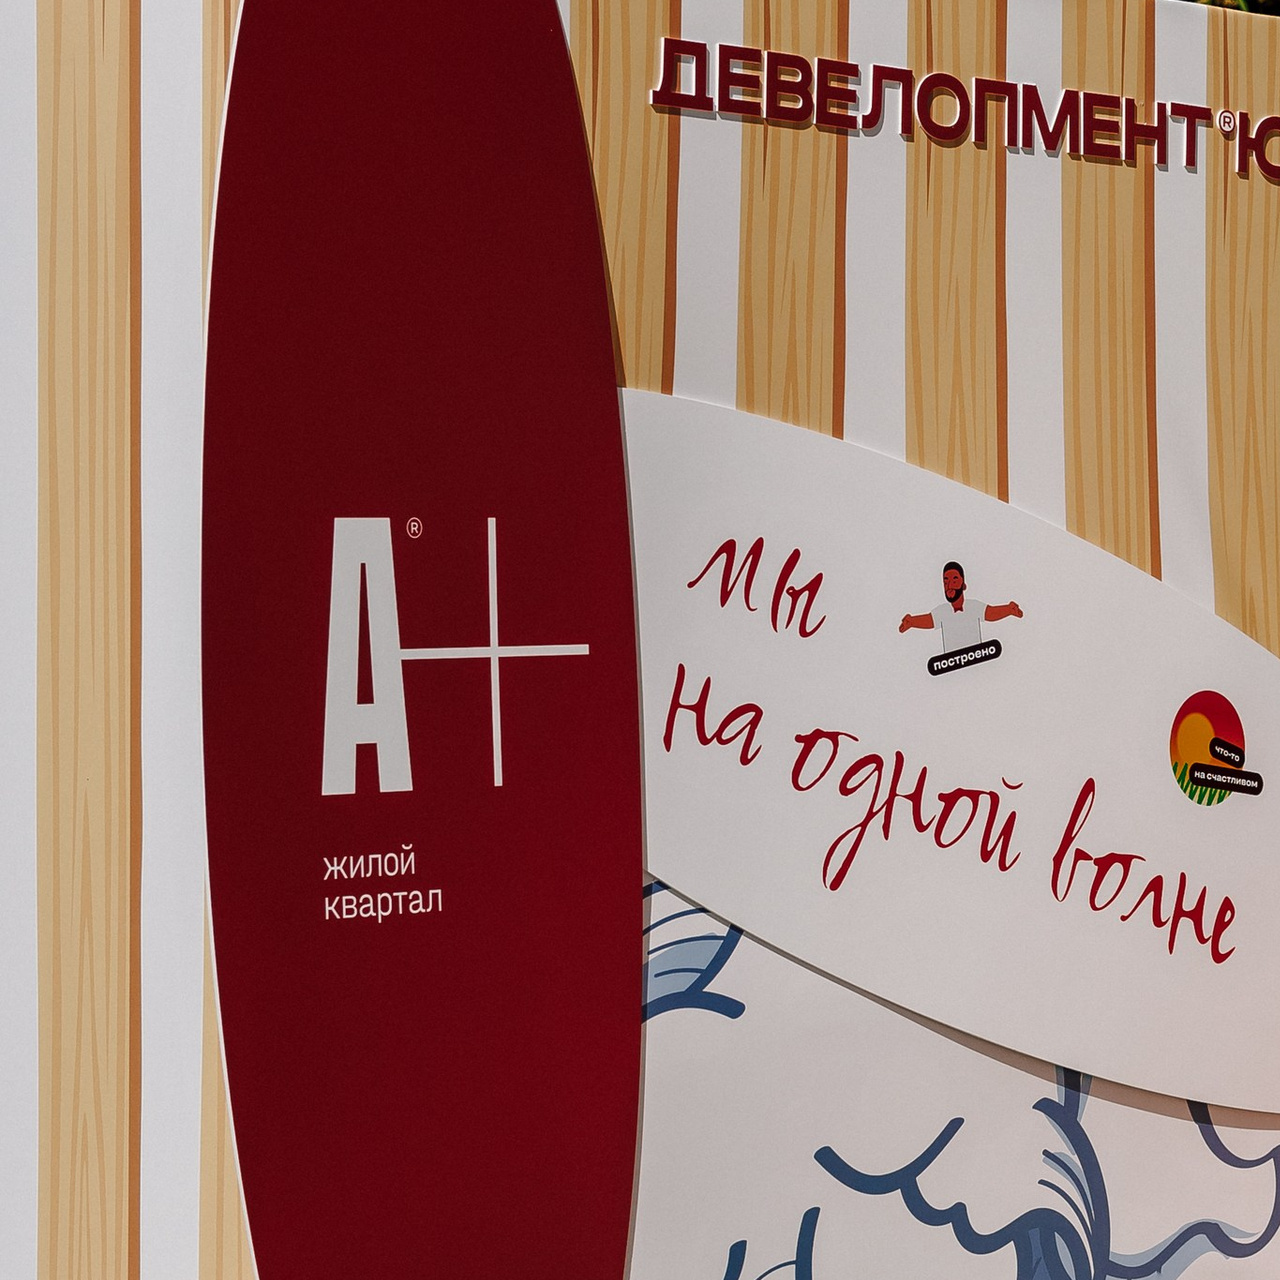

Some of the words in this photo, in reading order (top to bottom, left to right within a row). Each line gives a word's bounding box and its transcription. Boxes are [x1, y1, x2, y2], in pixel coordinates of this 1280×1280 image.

[933, 645, 996, 671] построено
[1215, 746, 1240, 762] что-то
[1194, 770, 1206, 780] на
[1206, 773, 1259, 788] счастливом
[791, 728, 1024, 891] одной
[1051, 777, 1236, 964] волне
[323, 843, 416, 881] жилой
[324, 888, 443, 924] квартал
